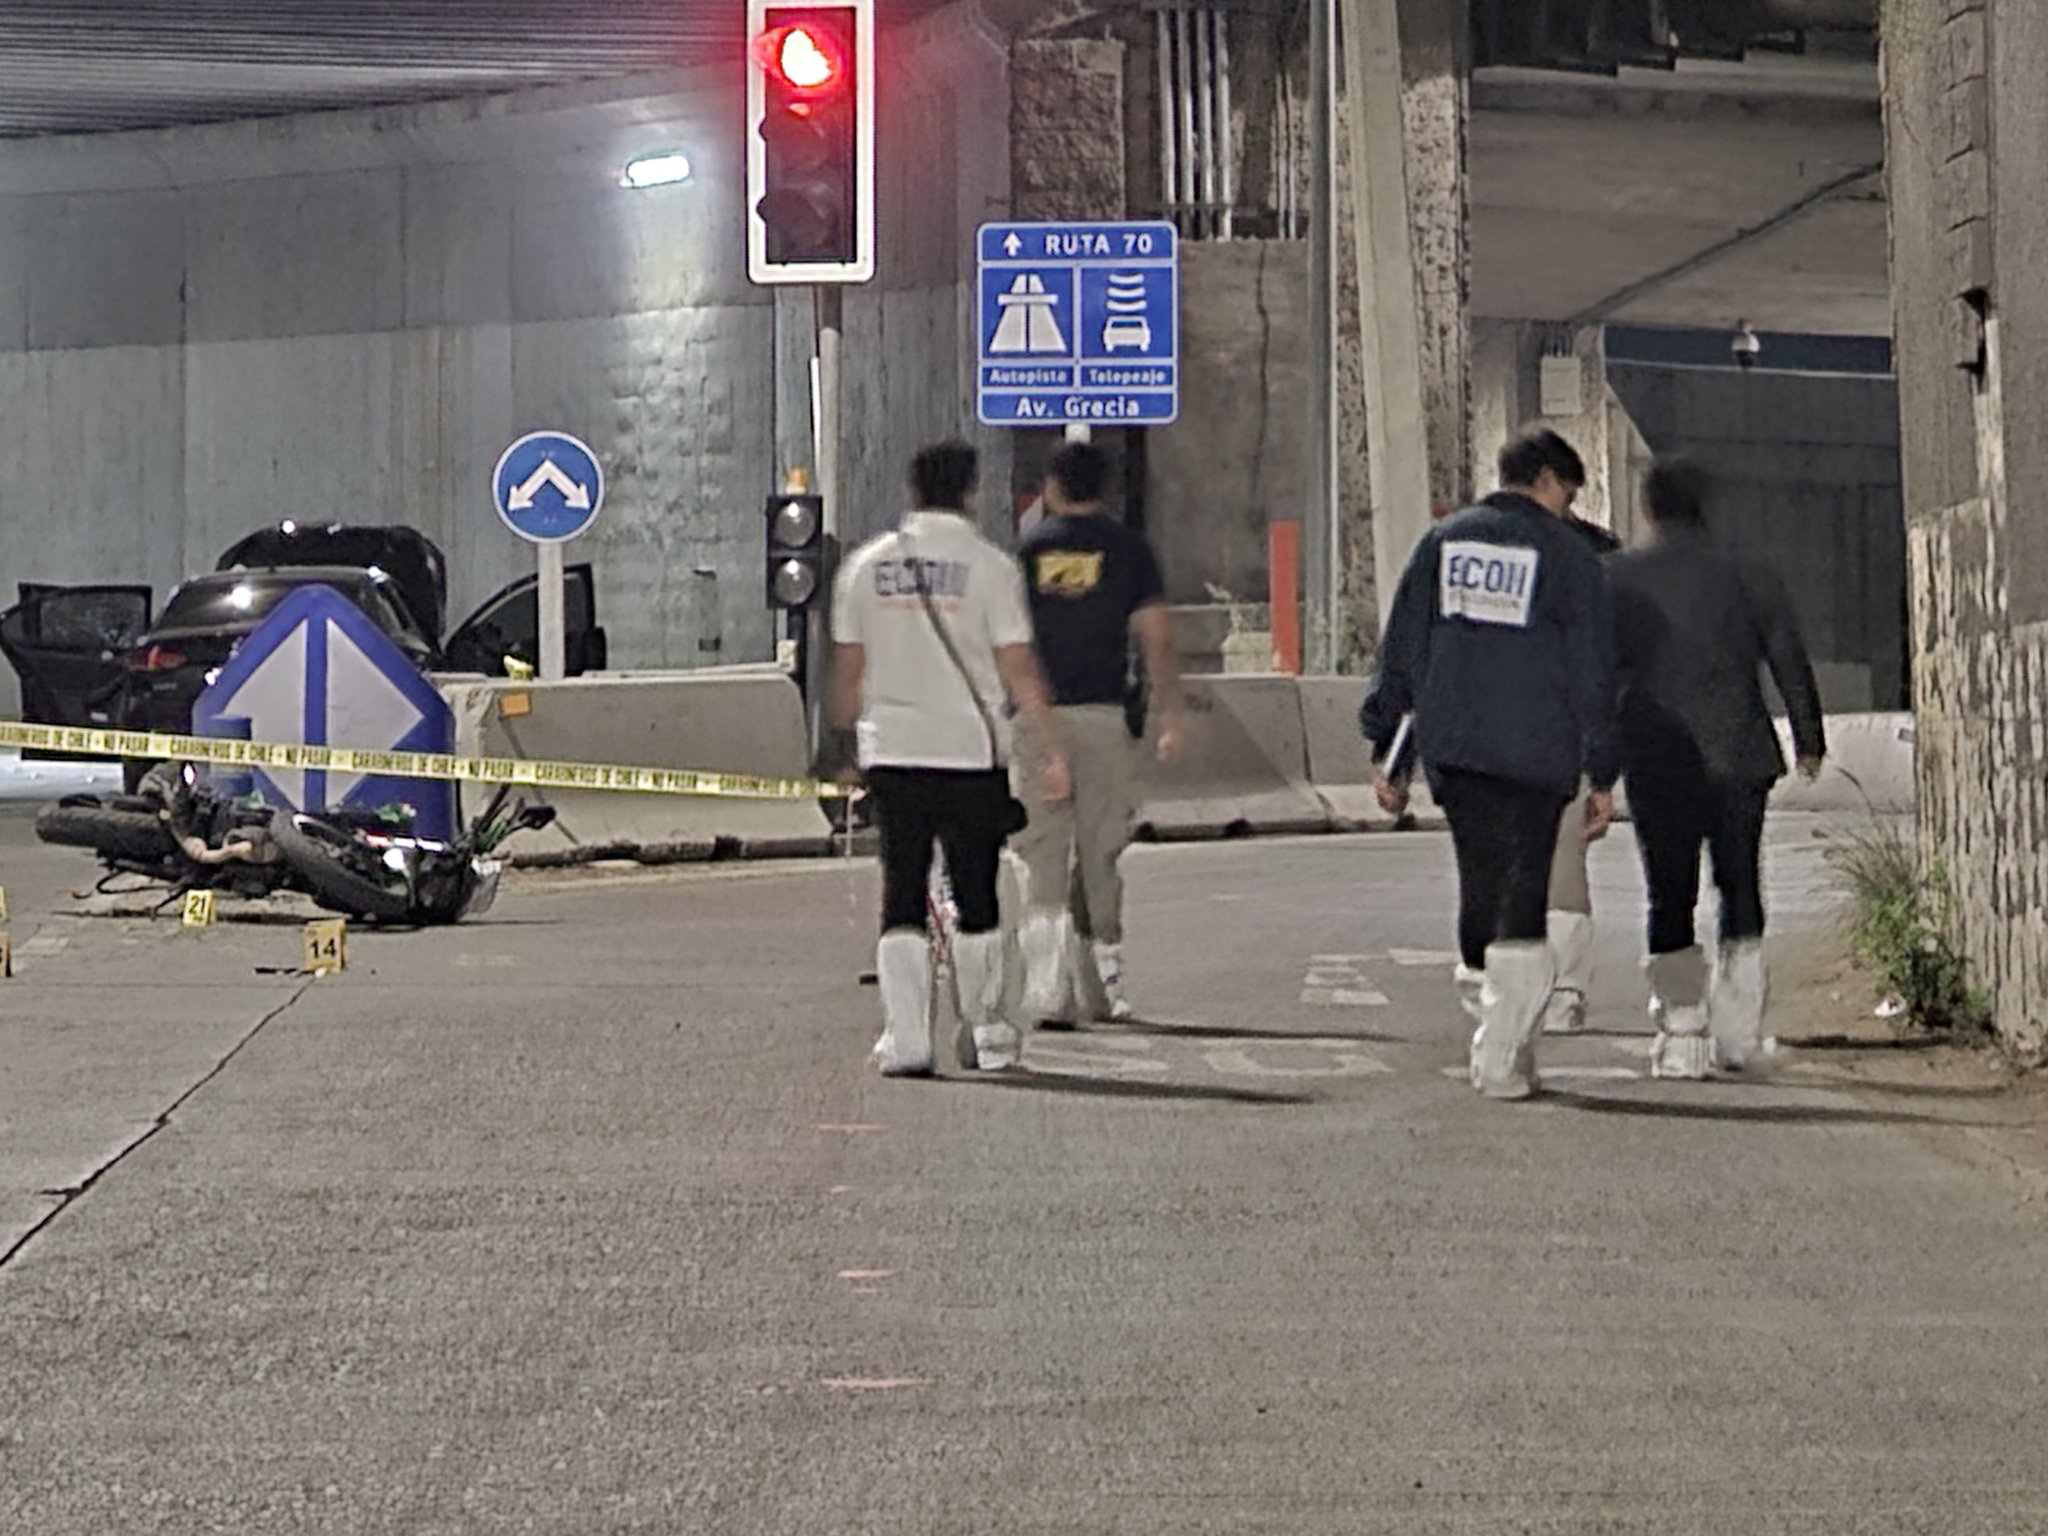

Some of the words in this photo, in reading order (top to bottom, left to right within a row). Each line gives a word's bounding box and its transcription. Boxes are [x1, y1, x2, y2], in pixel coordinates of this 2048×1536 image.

[1045, 233, 1110, 255] RUTA
[1123, 232, 1153, 255] 70
[989, 368, 1067, 387] Autopista
[1089, 368, 1166, 387] Telepeaje
[1016, 396, 1054, 417] Av.
[1064, 395, 1140, 417] Grecia
[189, 895, 206, 914] 21
[310, 938, 336, 959] 14
